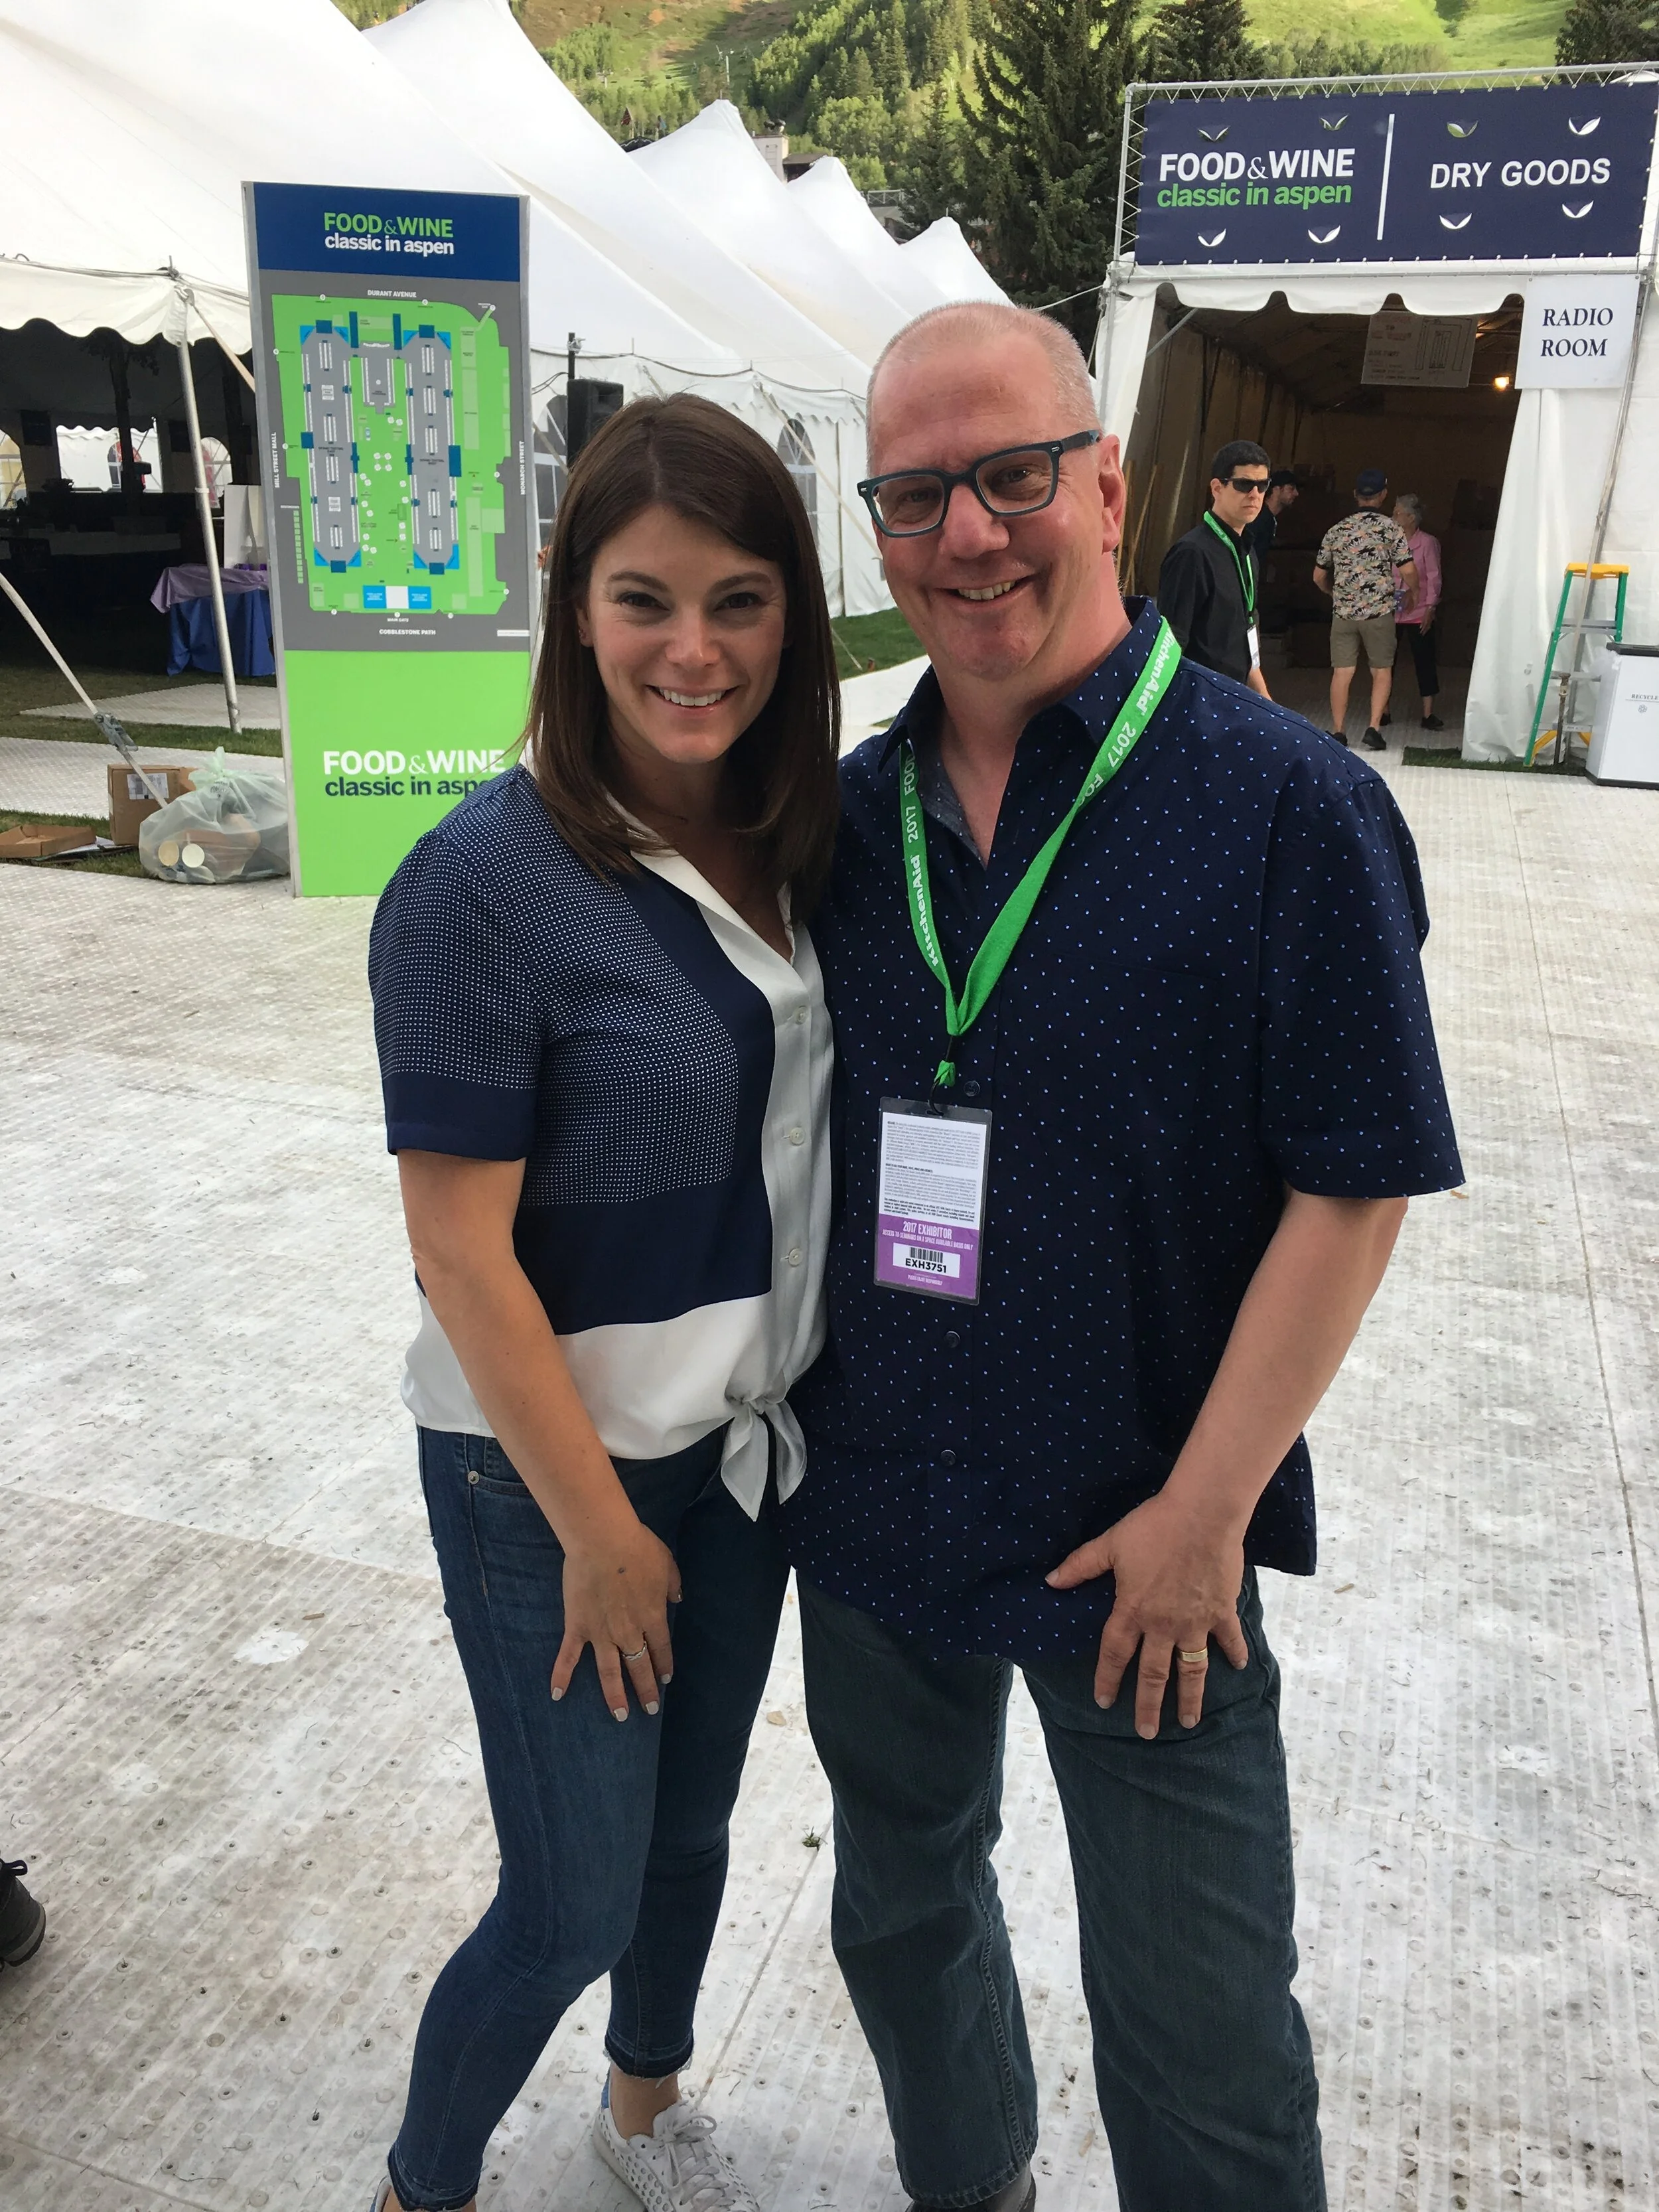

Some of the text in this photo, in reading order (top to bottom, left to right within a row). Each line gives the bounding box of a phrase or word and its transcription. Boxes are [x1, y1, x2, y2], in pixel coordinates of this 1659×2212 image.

[1430, 158, 1611, 188] DRY GOODS
[1157, 181, 1352, 210] classic in aspen
[325, 232, 455, 257] classic in aspen
[1542, 308, 1613, 326] RADIO
[1540, 338, 1608, 357] ROOM
[1108, 721, 1136, 769] 2017
[325, 776, 405, 796] classic
[411, 776, 431, 795] in
[906, 806, 918, 844] 2017
[910, 854, 939, 967] KitchenAid
[902, 1220, 952, 1239] 2017 EXHIBITOR
[905, 1258, 947, 1273] EXH3751
